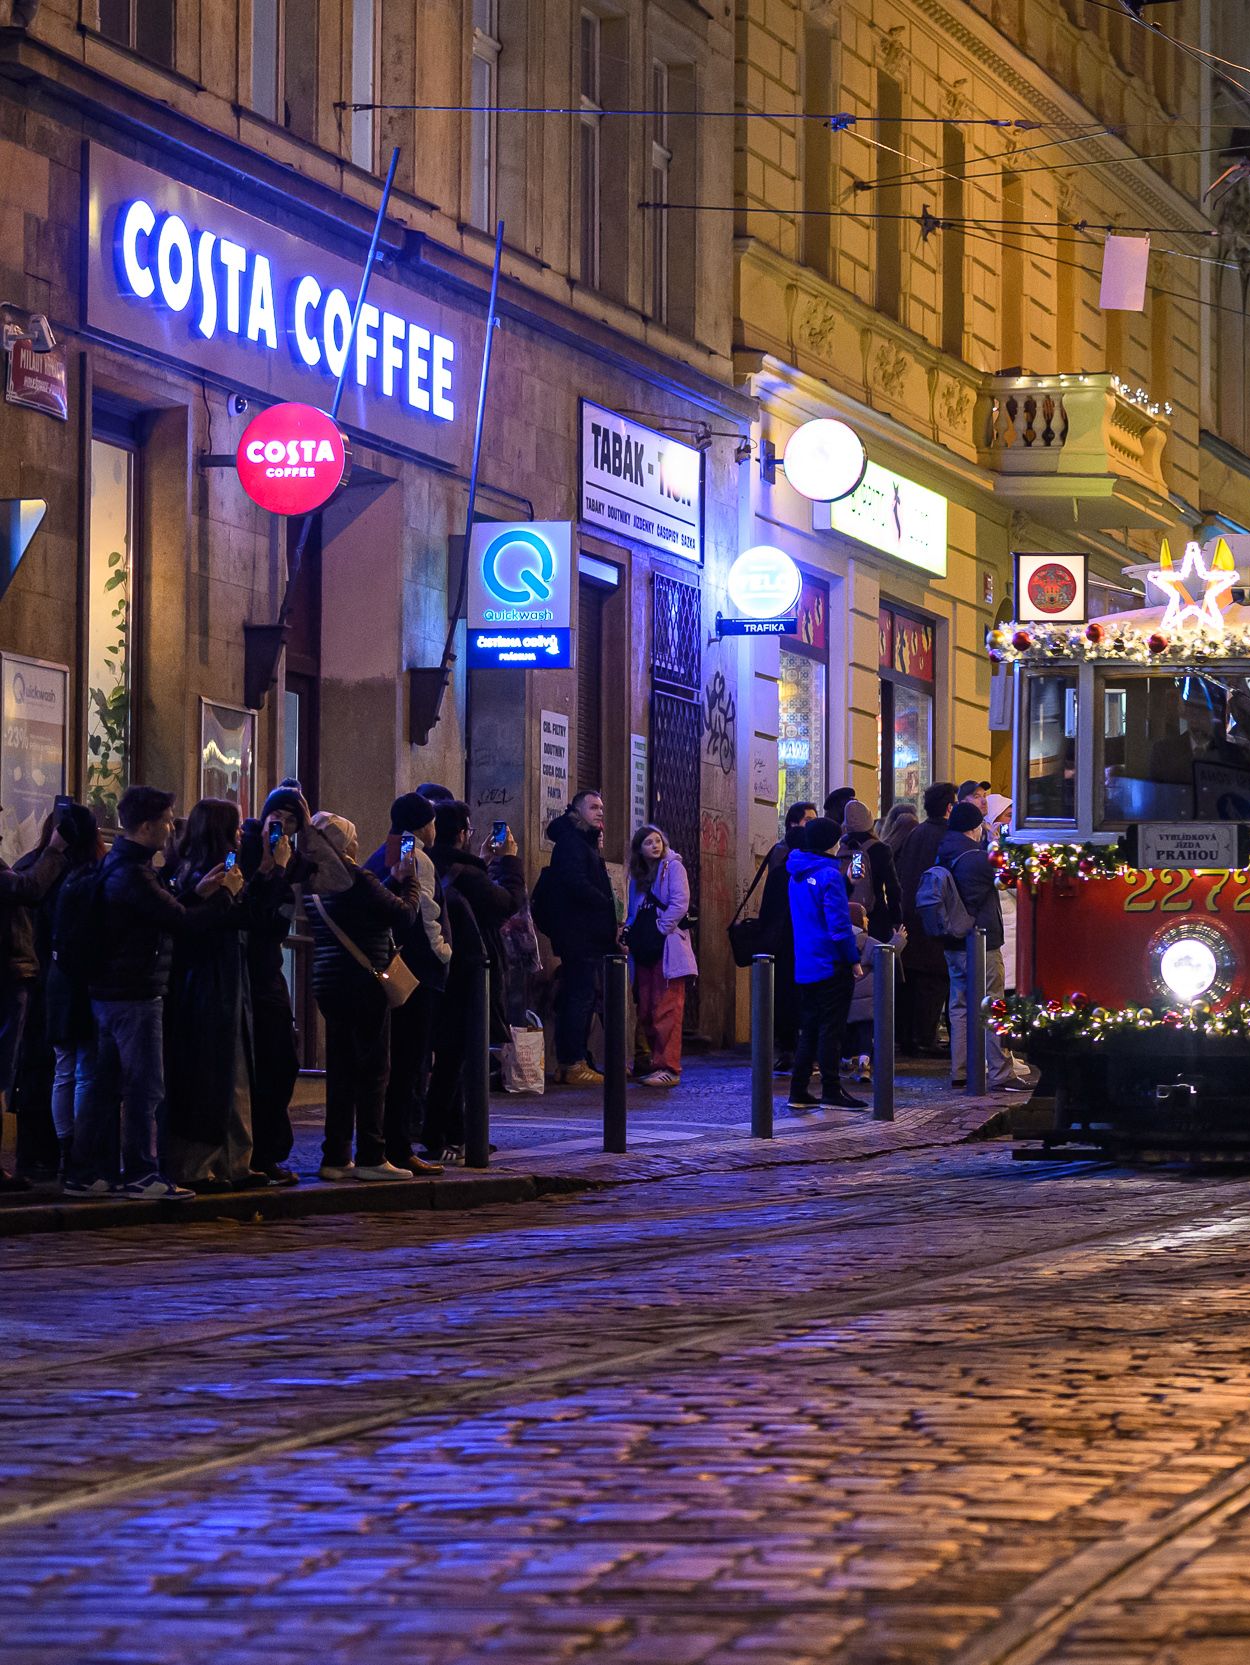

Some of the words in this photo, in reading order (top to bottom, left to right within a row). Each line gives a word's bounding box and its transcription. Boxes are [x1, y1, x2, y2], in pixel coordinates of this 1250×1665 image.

[123, 200, 278, 350] COSTA
[294, 275, 455, 422] COFFEE
[246, 440, 335, 465] COSTA
[591, 422, 645, 488] TABÁK
[266, 468, 316, 478] COFFEE
[483, 608, 554, 621] Quickwash
[743, 624, 786, 633] TRAFIKA
[542, 763, 554, 777] COCA
[555, 766, 567, 780] COLA
[547, 786, 562, 801] FANTA
[1158, 832, 1217, 841] VYHLÍDKOVÁ
[1174, 840, 1201, 849] JÍZDA
[1156, 850, 1219, 861] PRAHOU
